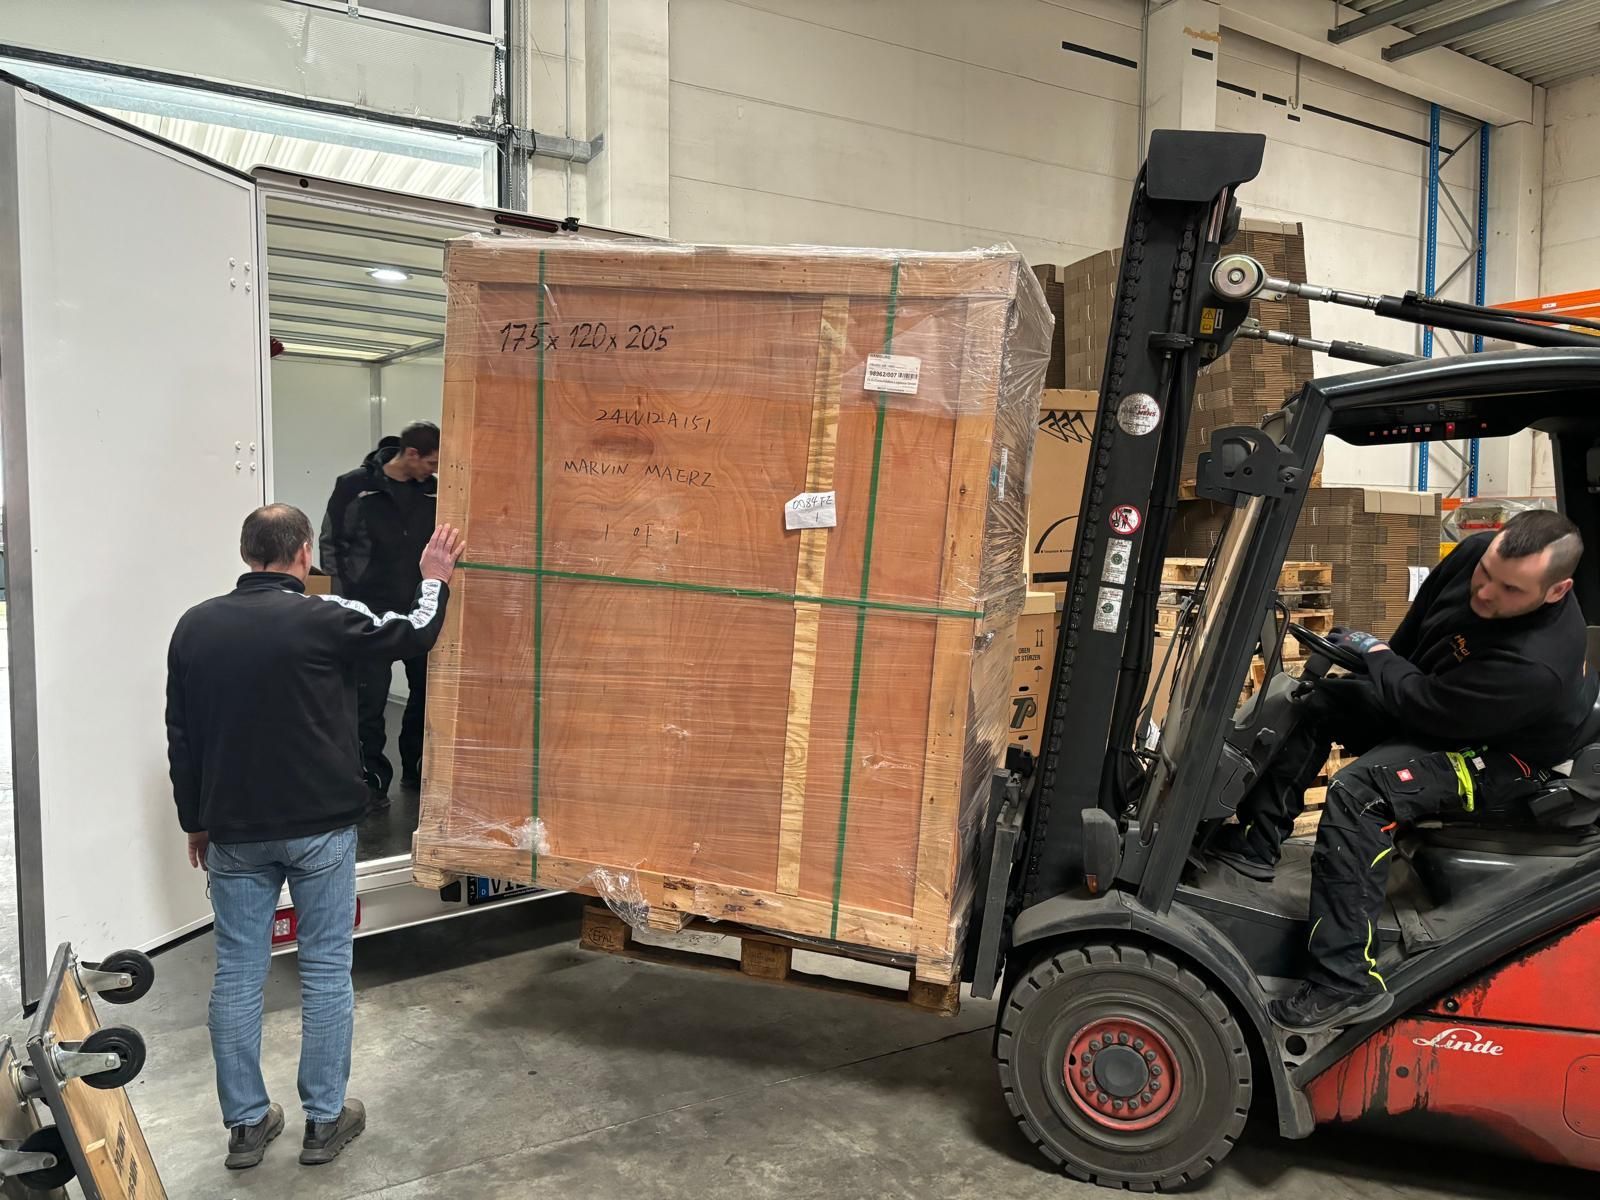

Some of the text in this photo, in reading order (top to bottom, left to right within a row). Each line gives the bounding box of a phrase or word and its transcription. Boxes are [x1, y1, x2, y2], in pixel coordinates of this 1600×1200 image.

[625, 325, 674, 351] 205
[564, 458, 716, 488] MARVIN MAERZ
[604, 523, 609, 542] 1
[1412, 1027, 1504, 1056] Linde
